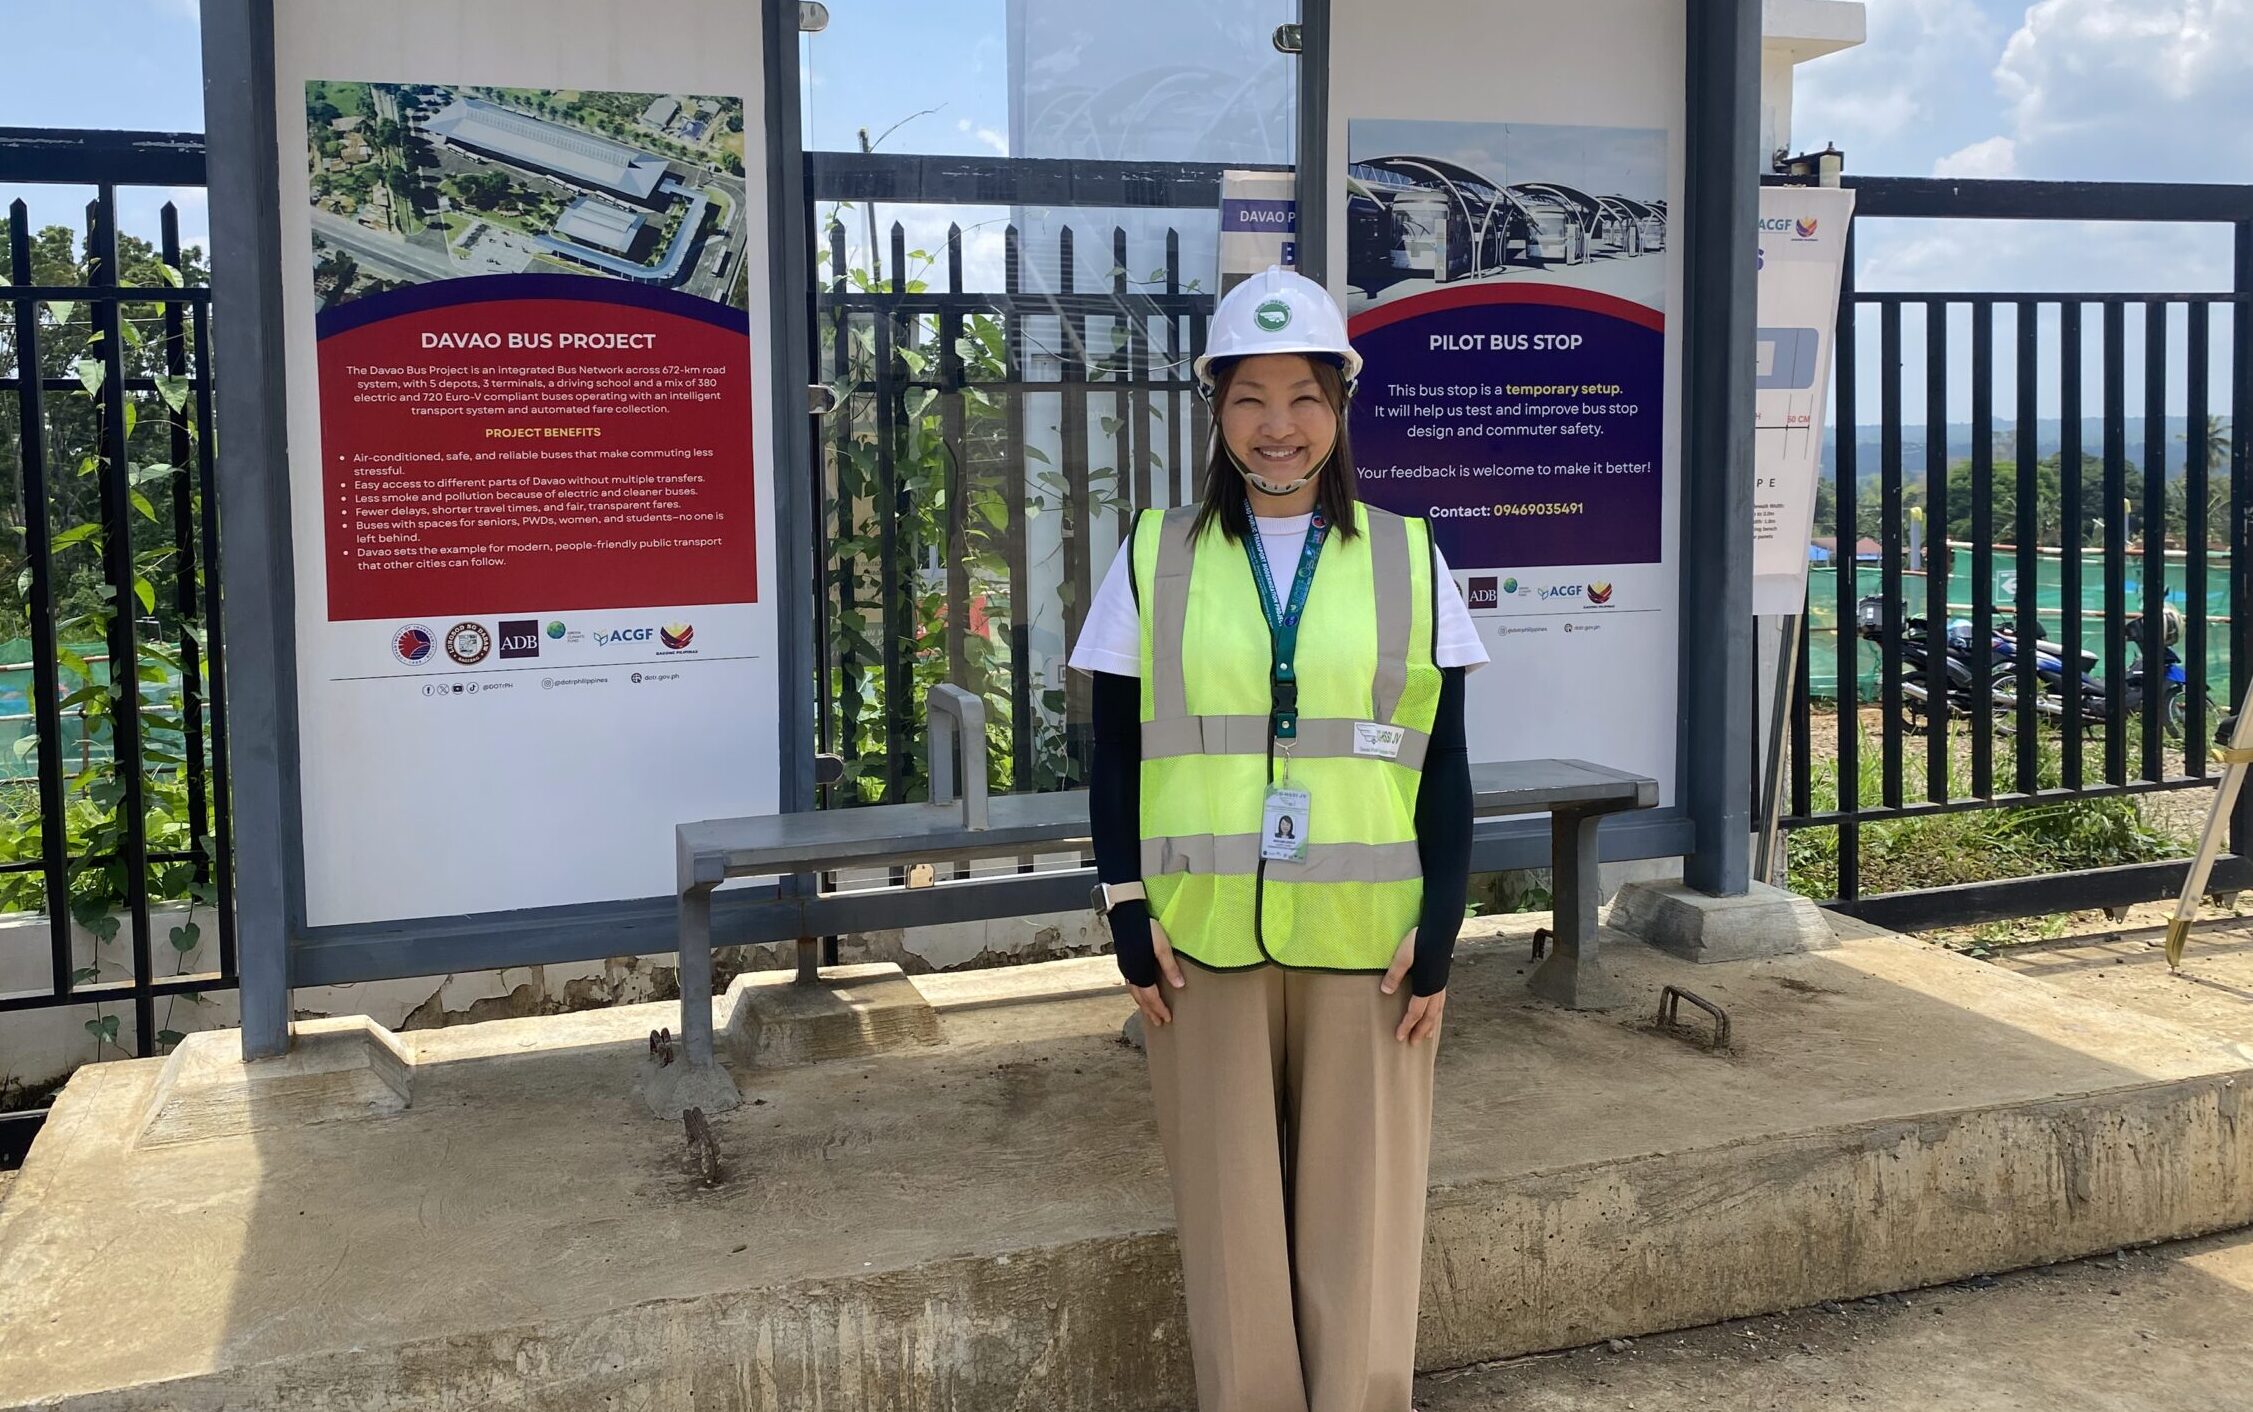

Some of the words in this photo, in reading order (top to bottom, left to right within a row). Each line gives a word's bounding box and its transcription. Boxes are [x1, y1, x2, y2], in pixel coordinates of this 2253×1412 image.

[1240, 210, 1285, 222] DAVAO
[1288, 212, 1295, 222] P
[1758, 219, 1792, 231] ACGF
[421, 332, 501, 348] DAVAO
[508, 332, 552, 348] BUS
[559, 333, 656, 348] PROJECT
[1430, 334, 1485, 350] PILOT
[1490, 334, 1528, 350] BUS
[1533, 334, 1582, 349] STOP
[346, 366, 367, 374] The
[369, 366, 404, 374] Davao
[406, 365, 427, 374] Bus
[429, 365, 468, 376] Project
[470, 365, 480, 374] is
[498, 366, 554, 376] Integrated
[557, 365, 576, 374] Bus
[578, 366, 623, 374] Network
[662, 365, 700, 374] 672-km
[702, 366, 726, 374] road
[353, 393, 396, 402] electric
[399, 392, 420, 401] and
[422, 392, 442, 401] 720
[445, 392, 481, 401] Euro-V
[483, 392, 539, 401] compliant
[541, 392, 573, 400] buses
[575, 392, 627, 402] operating
[628, 391, 652, 400] with
[669, 391, 721, 401] intelligent
[1387, 384, 1416, 396] This
[1419, 384, 1444, 396] bus
[1446, 385, 1477, 397] stop
[1480, 383, 1491, 395] is
[1494, 386, 1502, 395] a
[1505, 385, 1578, 396] temporary
[1581, 384, 1622, 396] setup.
[411, 407, 464, 415] transport
[466, 407, 505, 416] system
[507, 405, 528, 414] and
[530, 405, 590, 413] automated
[592, 404, 613, 413] fare
[615, 404, 669, 413] collection.
[1375, 405, 1384, 417] It
[1387, 404, 1410, 416] will
[1414, 404, 1444, 418] help
[1446, 406, 1462, 416] us
[1465, 405, 1492, 416] test
[1495, 403, 1521, 415] and
[1524, 403, 1579, 416] improve
[1582, 403, 1606, 414] bus
[1608, 403, 1638, 415] stop
[485, 428, 541, 437] PROJECT
[544, 427, 600, 437] BENEFITS
[1406, 425, 1453, 439] design
[1456, 424, 1482, 436] and
[1486, 425, 1557, 435] commuter
[1560, 422, 1603, 436] safety.
[353, 452, 444, 462] Air-conditioned,
[446, 451, 472, 460] safe,
[474, 451, 496, 460] and
[498, 450, 538, 459] reliable
[540, 450, 573, 459] buses
[574, 450, 597, 458] that
[599, 449, 628, 458] make
[630, 448, 691, 458] commuting
[693, 448, 713, 456] less
[353, 466, 404, 475] stressful.
[1356, 467, 1388, 478] Your
[1390, 465, 1456, 478] feedback
[1459, 464, 1470, 476] is
[1472, 464, 1534, 476] welcome
[1536, 464, 1551, 475] to
[1554, 463, 1590, 474] make
[1593, 462, 1602, 473] it
[1606, 462, 1650, 473] better!
[354, 480, 380, 490] Easy
[423, 480, 435, 488] to
[436, 478, 486, 487] different
[488, 478, 517, 488] parts
[518, 476, 530, 485] of
[532, 477, 566, 485] Davao
[567, 476, 608, 484] without
[611, 475, 654, 484] multiple
[656, 473, 705, 482] transfers.
[355, 494, 380, 502] Less
[381, 493, 418, 502] smoke
[420, 492, 442, 501] and
[444, 491, 493, 502] pollution
[496, 491, 542, 499] because
[544, 489, 556, 498] of
[557, 489, 598, 498] electric
[600, 488, 621, 497] and
[622, 488, 662, 497] cleaner
[355, 507, 389, 516] Fewer
[390, 506, 429, 516] delays,
[431, 506, 472, 514] shorter
[474, 504, 505, 513] travel
[507, 503, 541, 512] times,
[543, 502, 564, 511] and
[565, 502, 586, 510] fair,
[588, 502, 650, 511] transparent
[652, 500, 680, 508] fares.
[1428, 504, 1490, 518] Contact:
[1494, 502, 1583, 517] 09469035491
[356, 521, 389, 529] Buses
[390, 519, 416, 528] with
[418, 520, 458, 529] spaces
[459, 517, 475, 526] for
[477, 517, 520, 526] seniors,
[522, 516, 556, 524] PWDs,
[603, 514, 623, 523] and
[715, 511, 724, 519] is
[356, 533, 376, 543] left
[378, 533, 420, 542] behind.
[357, 548, 392, 556] Davao
[393, 547, 417, 555] sets
[418, 546, 438, 554] the
[439, 544, 486, 554] example
[488, 543, 504, 552] for
[506, 543, 552, 551] modern,
[555, 539, 637, 551] people-friendly
[639, 538, 671, 548] public
[673, 538, 722, 546] transport
[357, 561, 381, 570] that
[383, 560, 414, 569] other
[416, 559, 446, 568] cities
[448, 559, 468, 567] can
[470, 557, 506, 566] follow.
[1469, 589, 1497, 602] ADB
[1550, 585, 1582, 597] ACGF
[610, 628, 653, 641] ACGF
[501, 635, 538, 650] ADB
